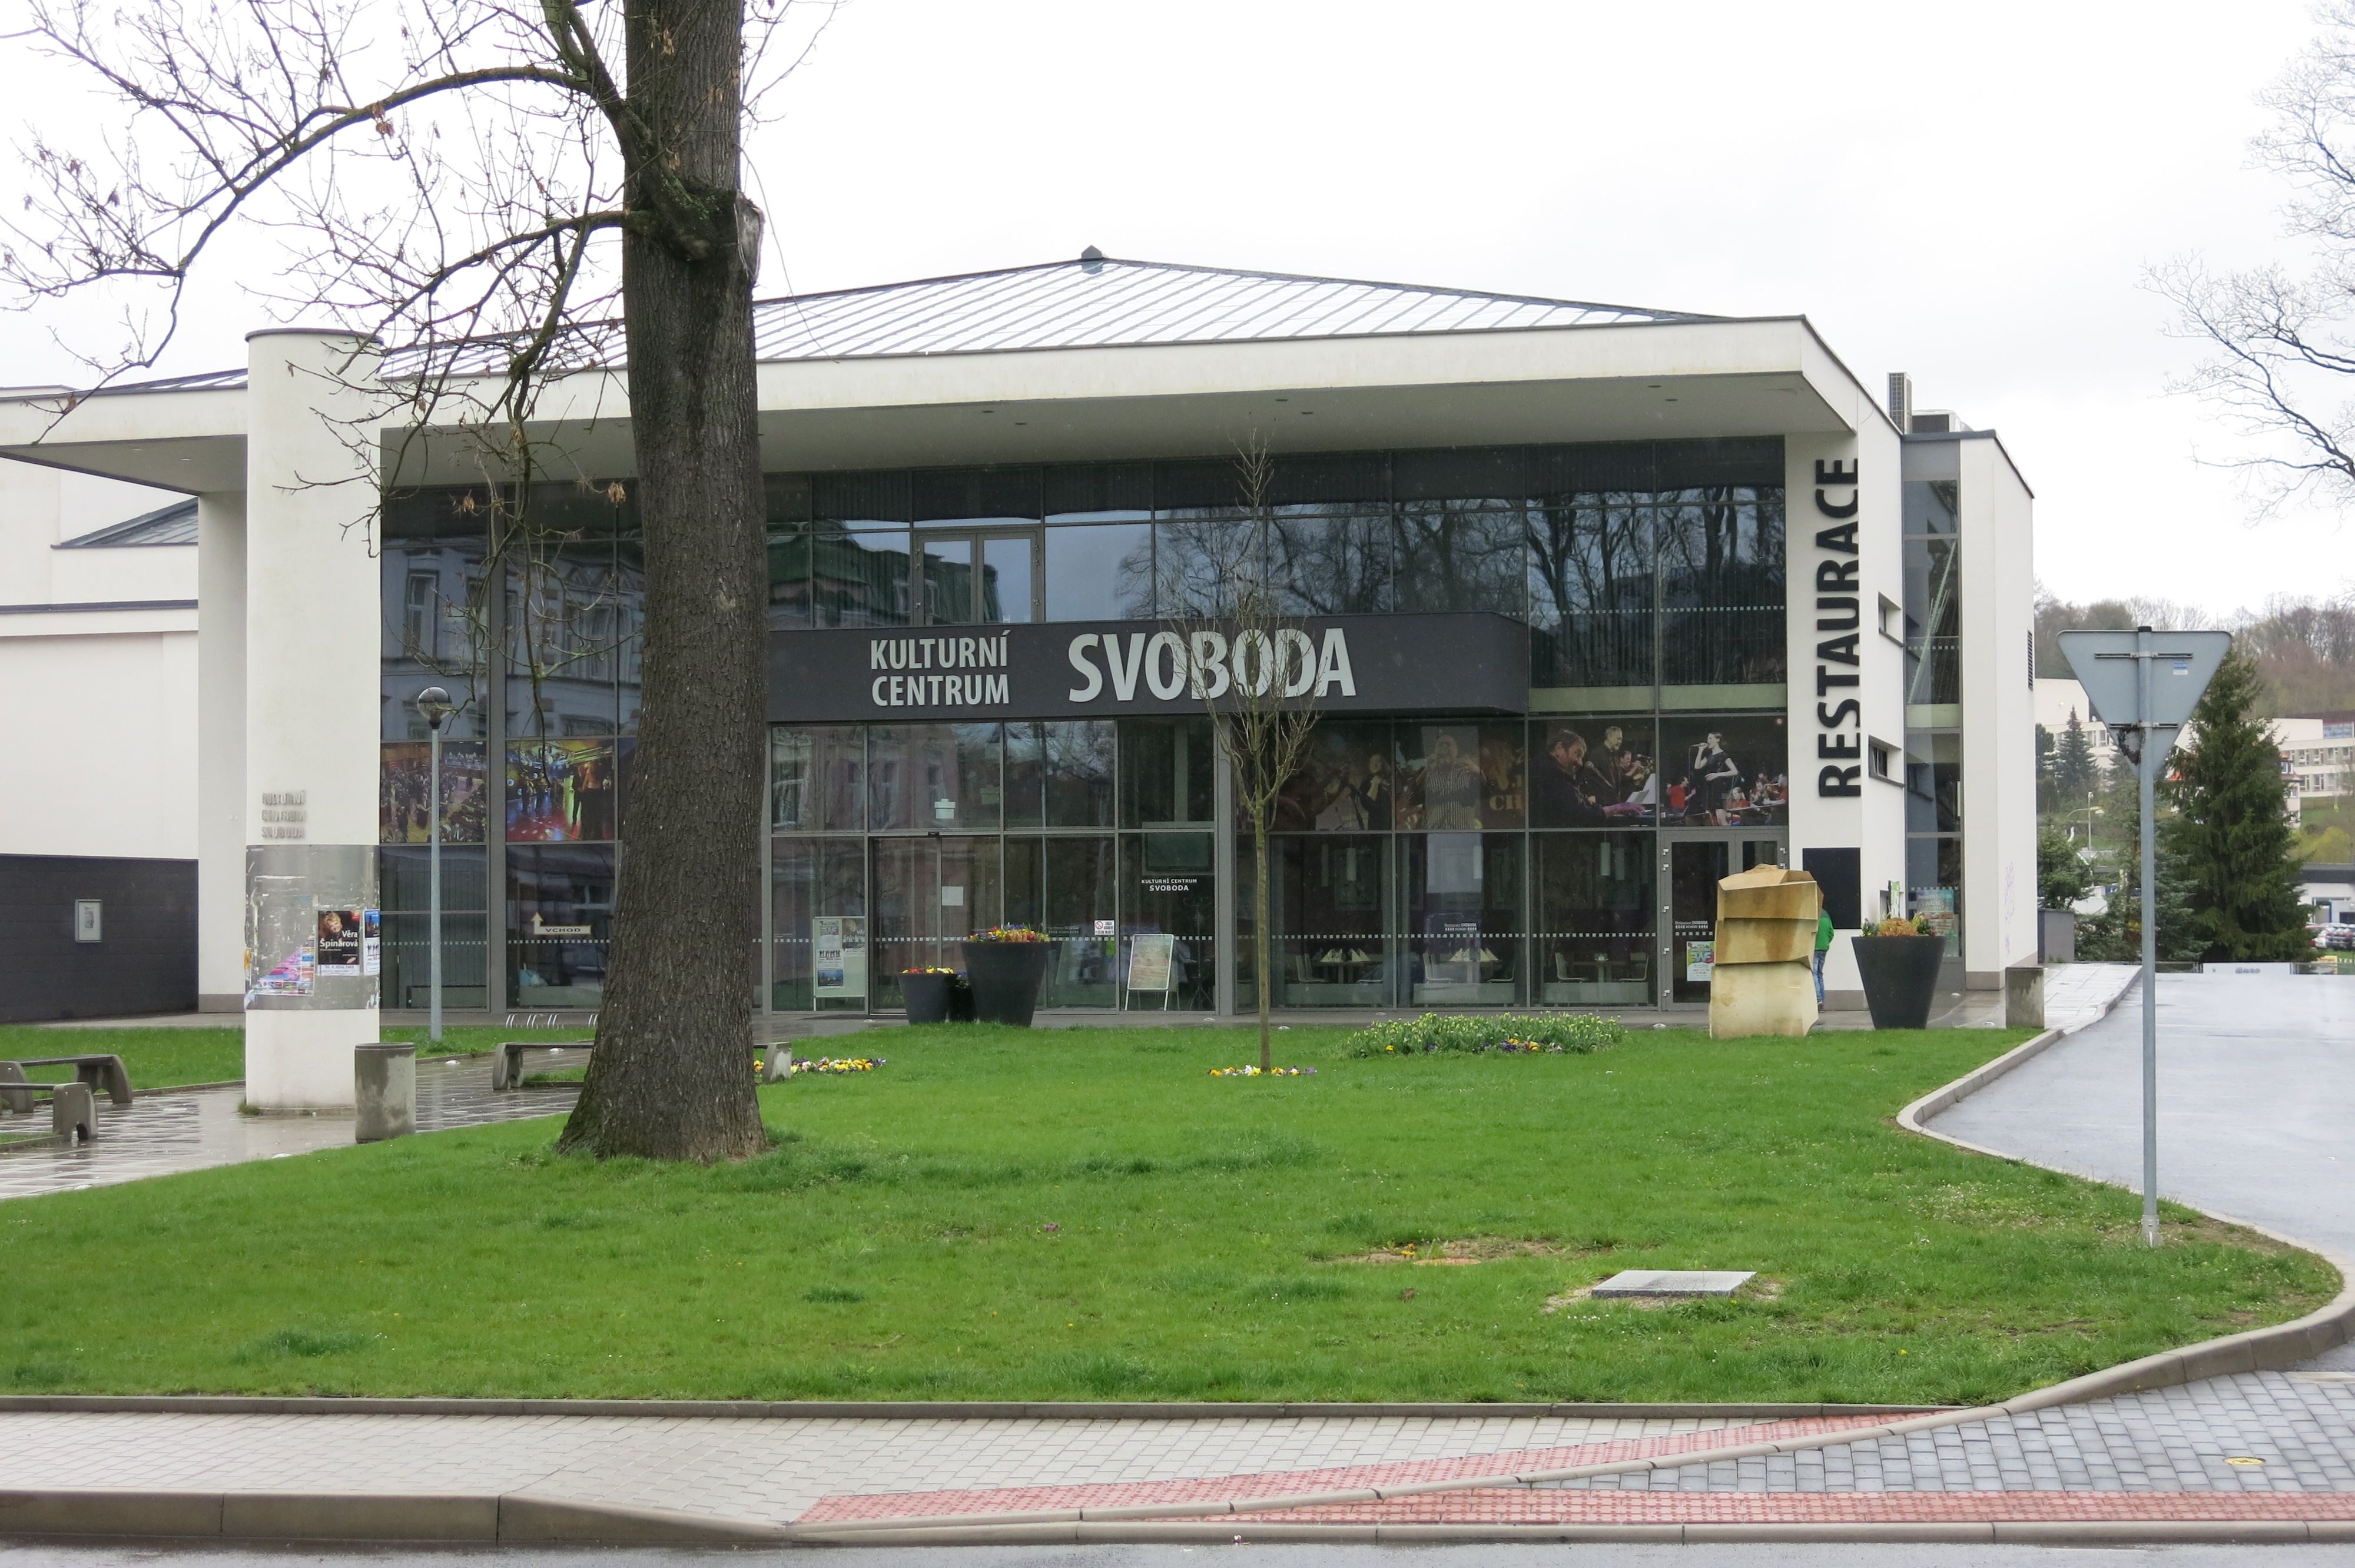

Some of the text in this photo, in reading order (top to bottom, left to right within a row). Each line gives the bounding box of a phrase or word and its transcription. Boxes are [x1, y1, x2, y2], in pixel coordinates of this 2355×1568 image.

[871, 630, 1010, 670] KULTURNÍ
[1816, 458, 1861, 797] RESTAURACE
[872, 674, 1009, 706] CENTRUM
[1068, 627, 1356, 702] SVOBODA
